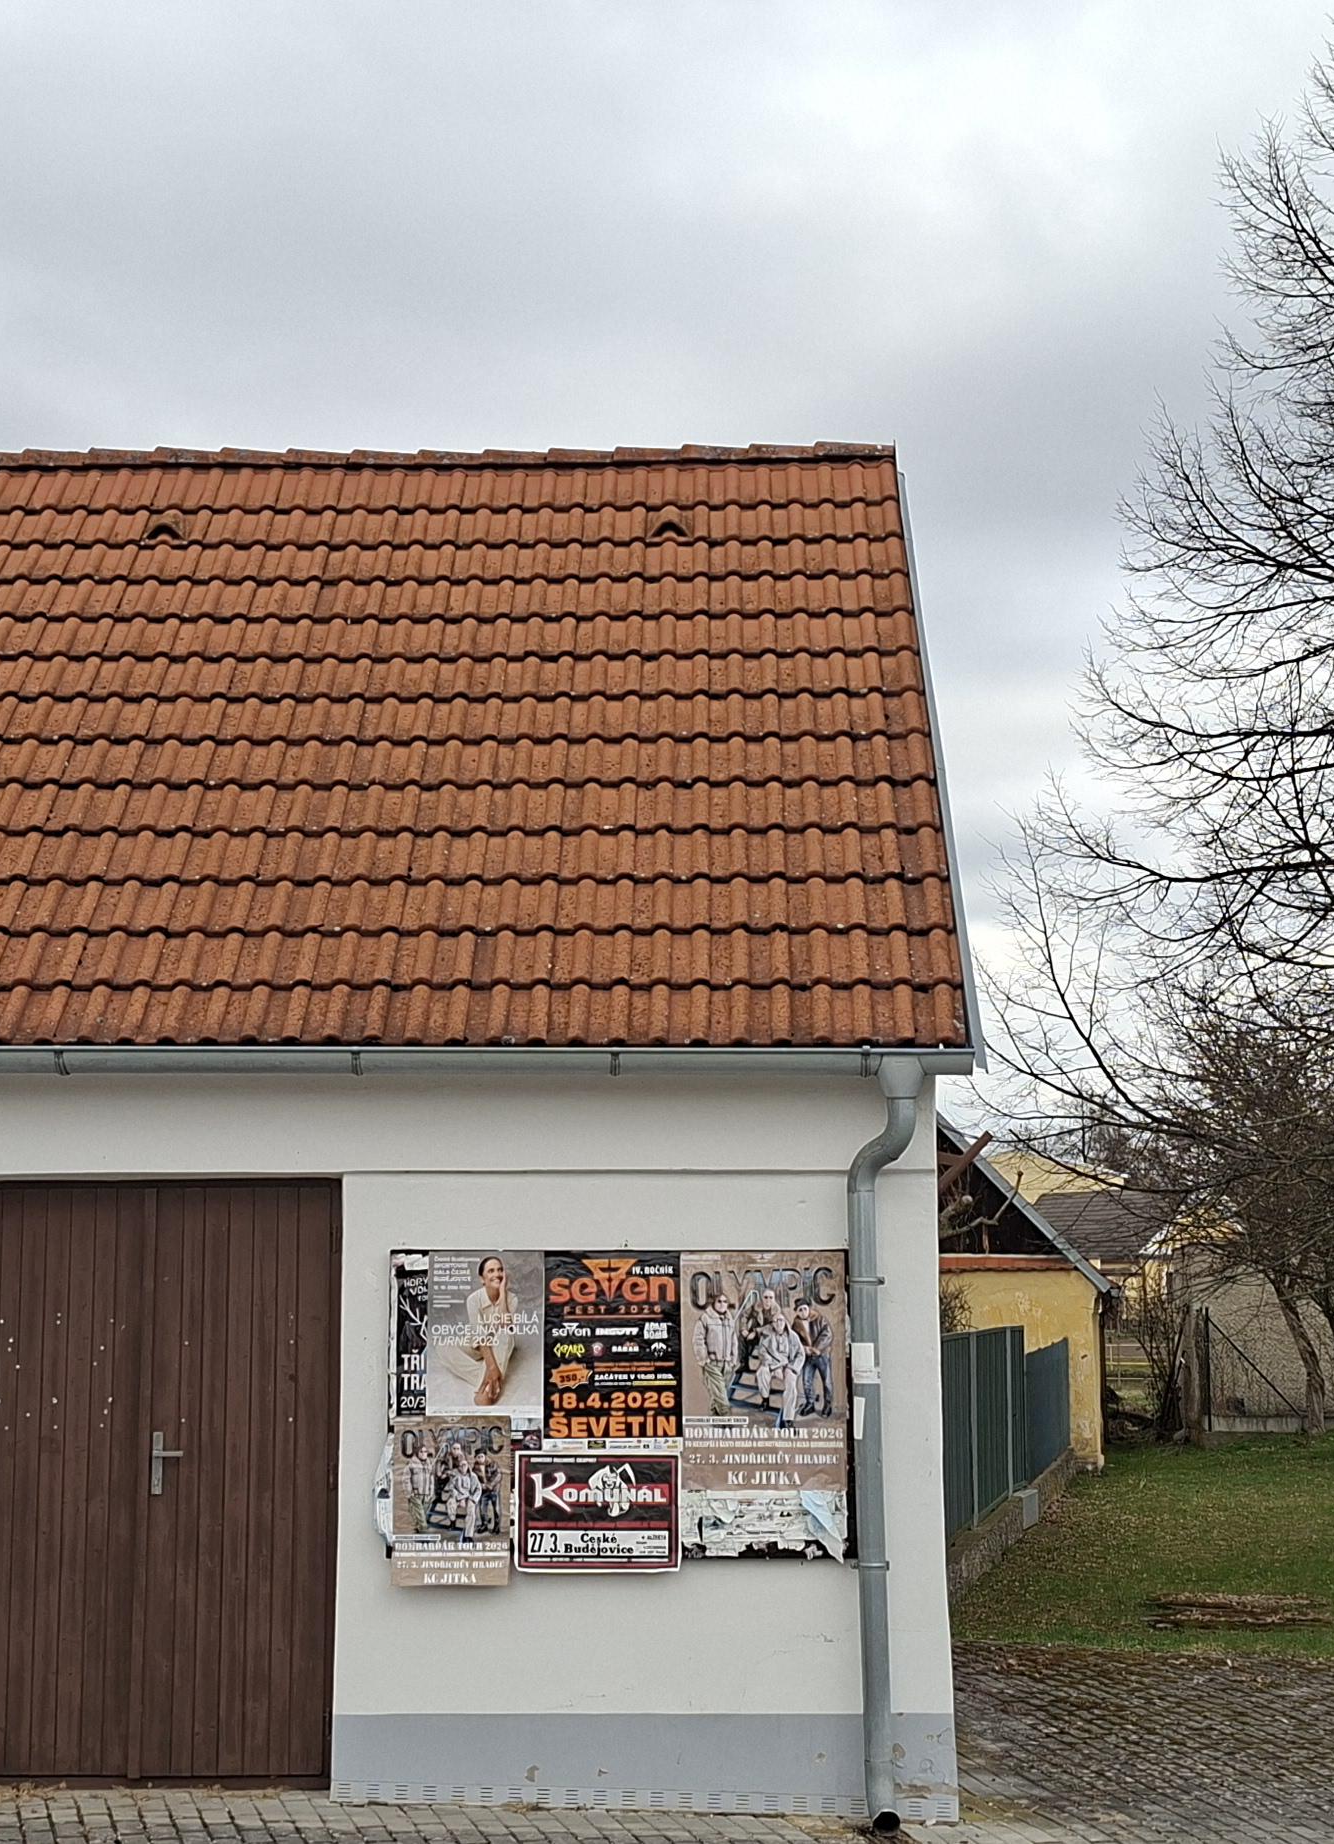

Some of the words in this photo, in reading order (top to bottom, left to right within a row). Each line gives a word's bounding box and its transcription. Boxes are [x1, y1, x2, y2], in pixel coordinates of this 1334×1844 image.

[690, 1266, 836, 1310] OLYMPIC
[563, 1305, 607, 1315] FEST
[618, 1304, 662, 1314] 2026
[478, 1313, 511, 1324] LUCIE
[513, 1311, 539, 1323] BÍLÁ
[432, 1322, 496, 1335] OBYČEJNÁ
[498, 1324, 539, 1335] HOLKA
[473, 1336, 500, 1347] 2026
[550, 1391, 675, 1409] 18.4.2026
[548, 1410, 677, 1438] ŠEVĚTÍN
[684, 1425, 769, 1439] BOMBARĎÁK
[771, 1427, 809, 1439] TOUR
[811, 1427, 844, 1439] 2026
[401, 1425, 505, 1459] OLYMPIC
[689, 1453, 706, 1465] 27.
[708, 1453, 719, 1465] 3.
[722, 1451, 791, 1465] JINDŘICHŮV
[794, 1453, 840, 1465] HRADEC
[727, 1470, 748, 1486] KC
[750, 1470, 802, 1486] JITKA
[580, 1532, 617, 1545] České
[564, 1543, 634, 1556] Budějovice
[423, 1573, 439, 1584] KC
[440, 1573, 477, 1584] JITKA
